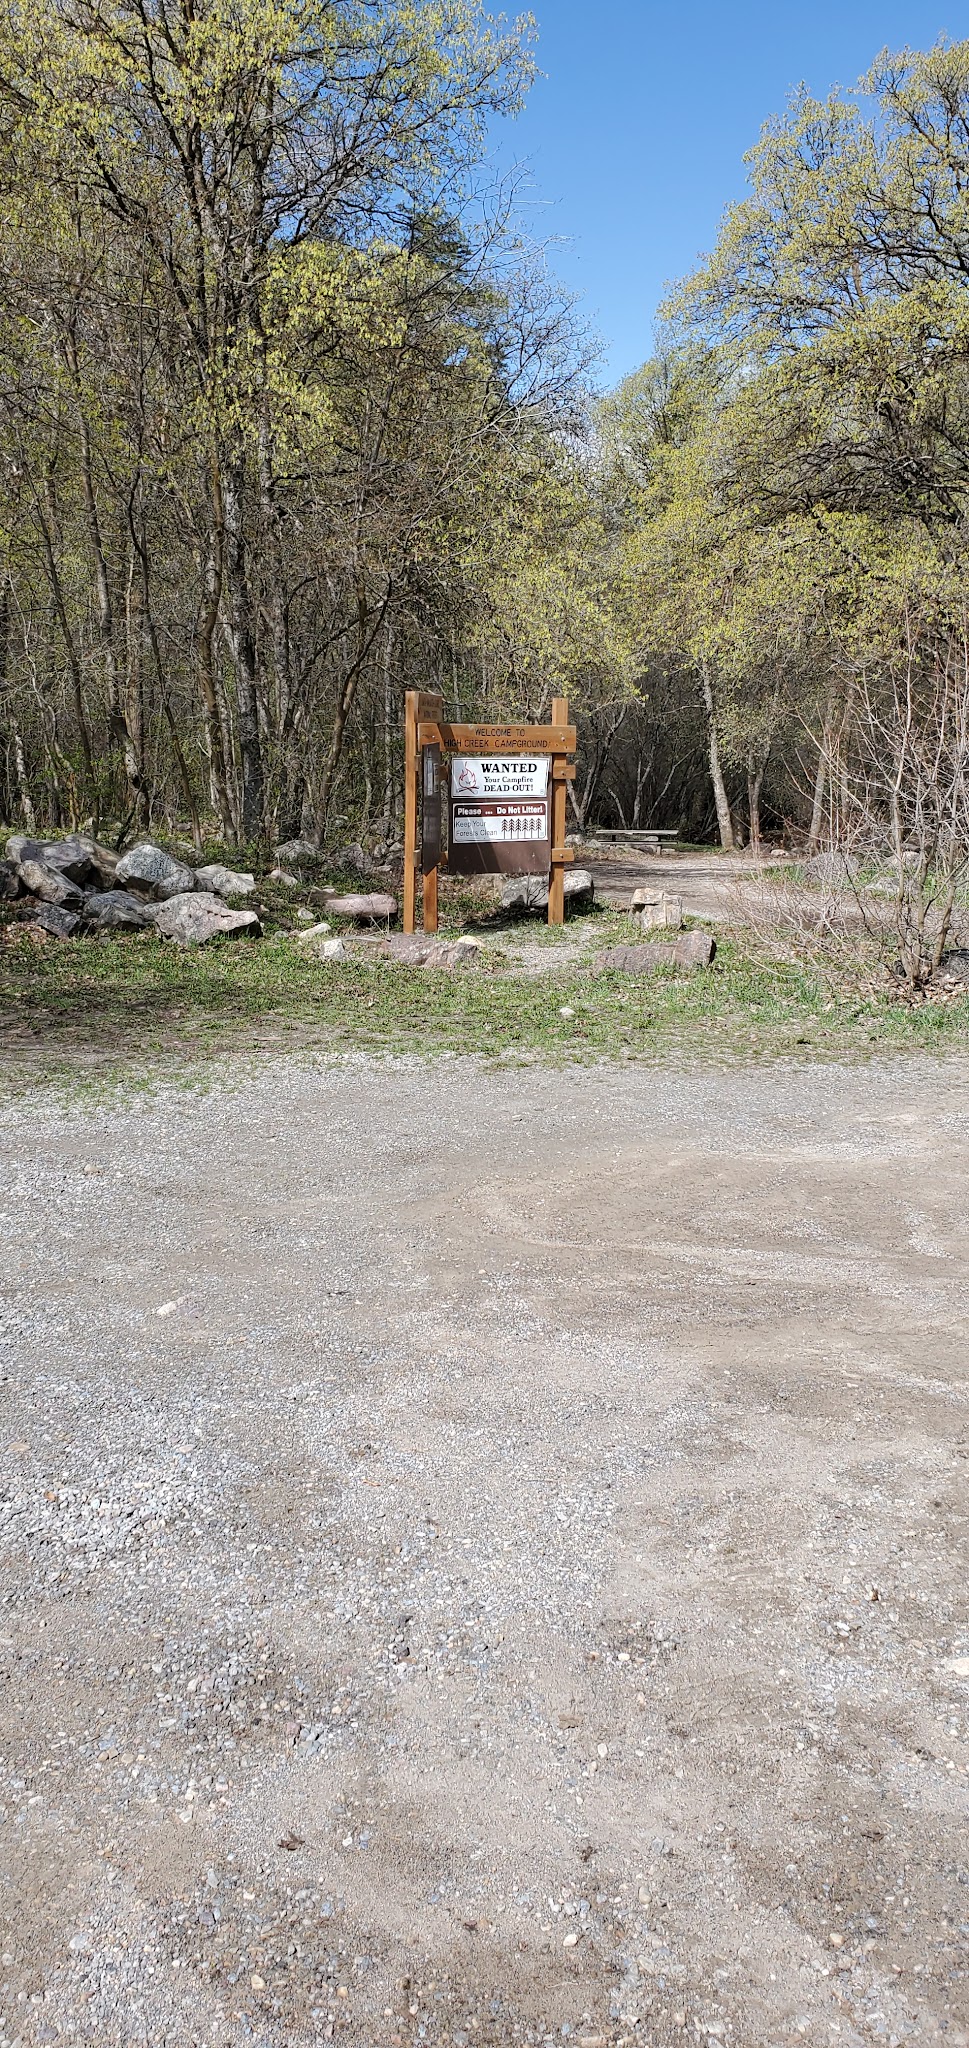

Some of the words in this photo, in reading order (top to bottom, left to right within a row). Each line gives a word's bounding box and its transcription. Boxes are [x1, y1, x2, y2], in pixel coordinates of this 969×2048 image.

[475, 728, 512, 737] WELCOME
[516, 728, 526, 737] TO
[444, 740, 462, 748] HIGH
[464, 740, 489, 748] CREEK
[481, 763, 537, 773] WANTED
[502, 776, 534, 784] Campfire
[522, 806, 543, 814] Litter!
